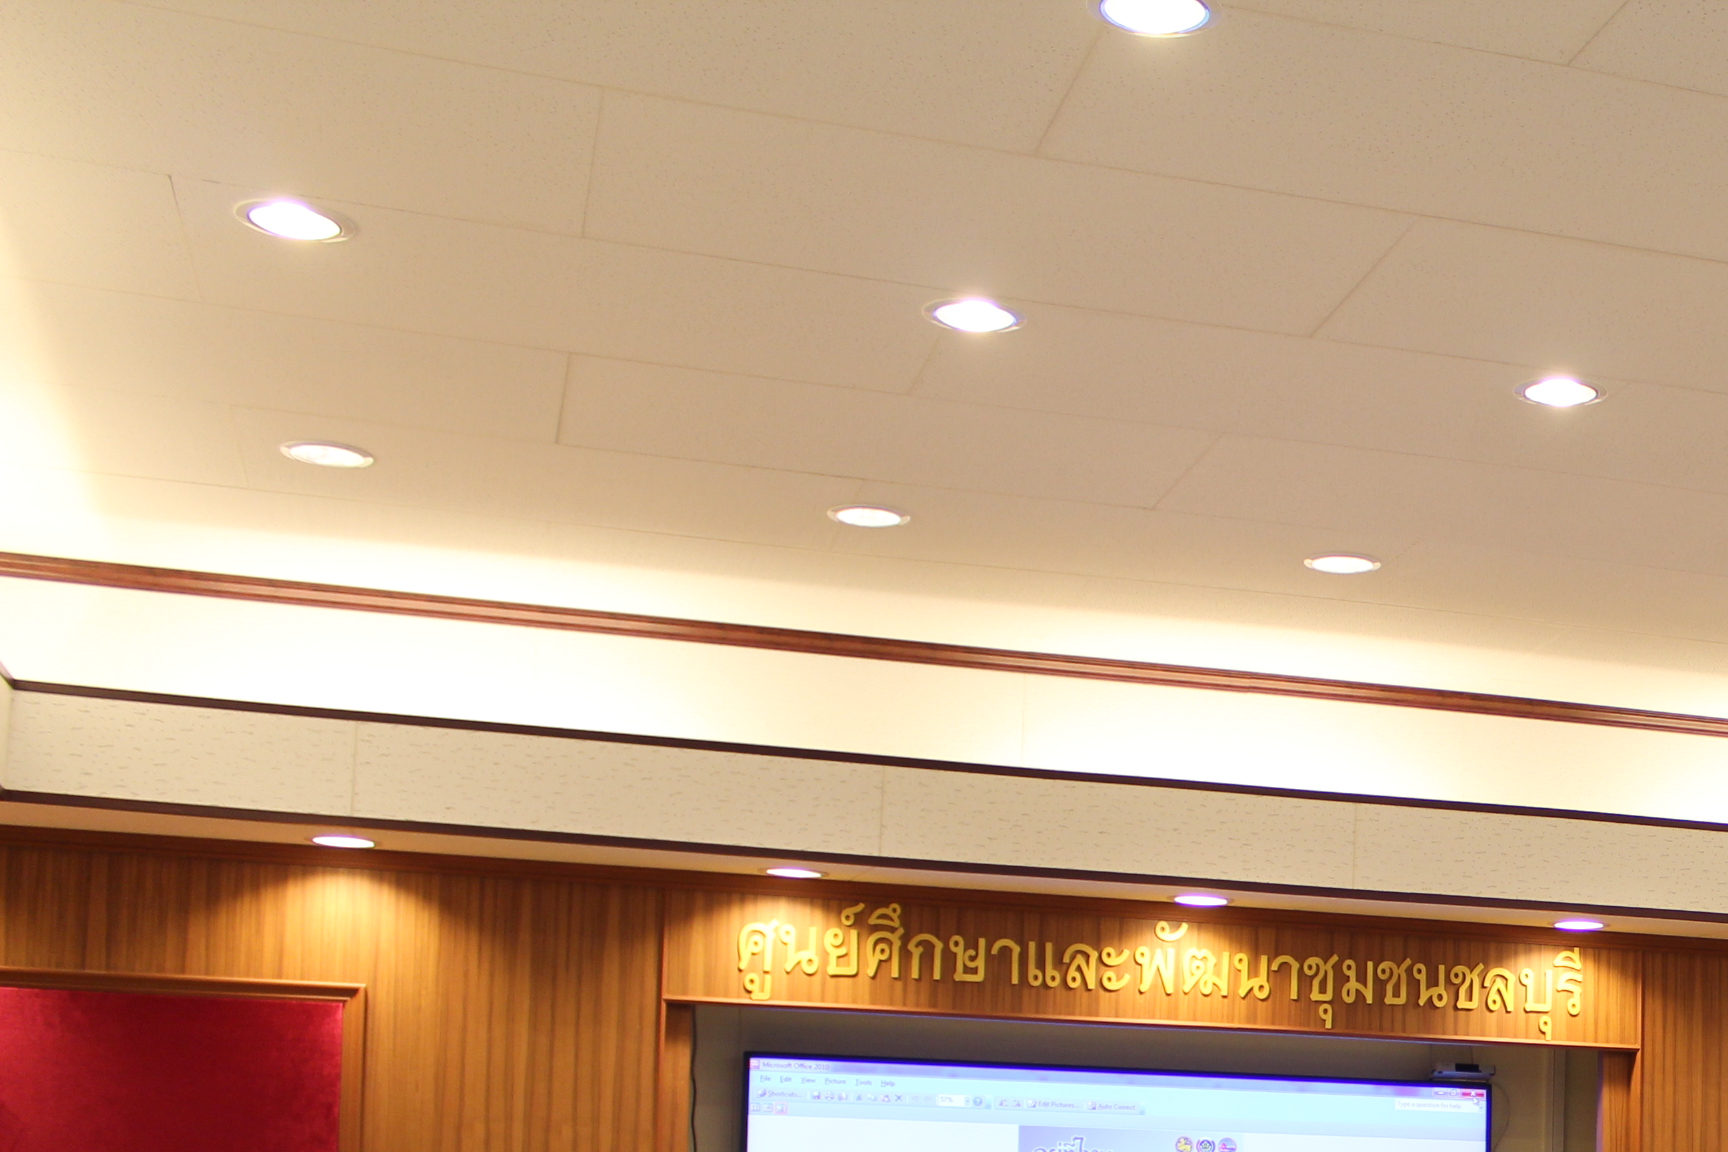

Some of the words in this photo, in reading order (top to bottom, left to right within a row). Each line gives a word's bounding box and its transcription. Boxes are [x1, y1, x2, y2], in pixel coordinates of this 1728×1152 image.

[735, 901, 1584, 1041] ศูนย์ศึกษาและพัฒนาชุมชนชลบุรี
[762, 1061, 792, 1069] Microsoft
[824, 1077, 847, 1085] Picture
[880, 1080, 896, 1088] Help
